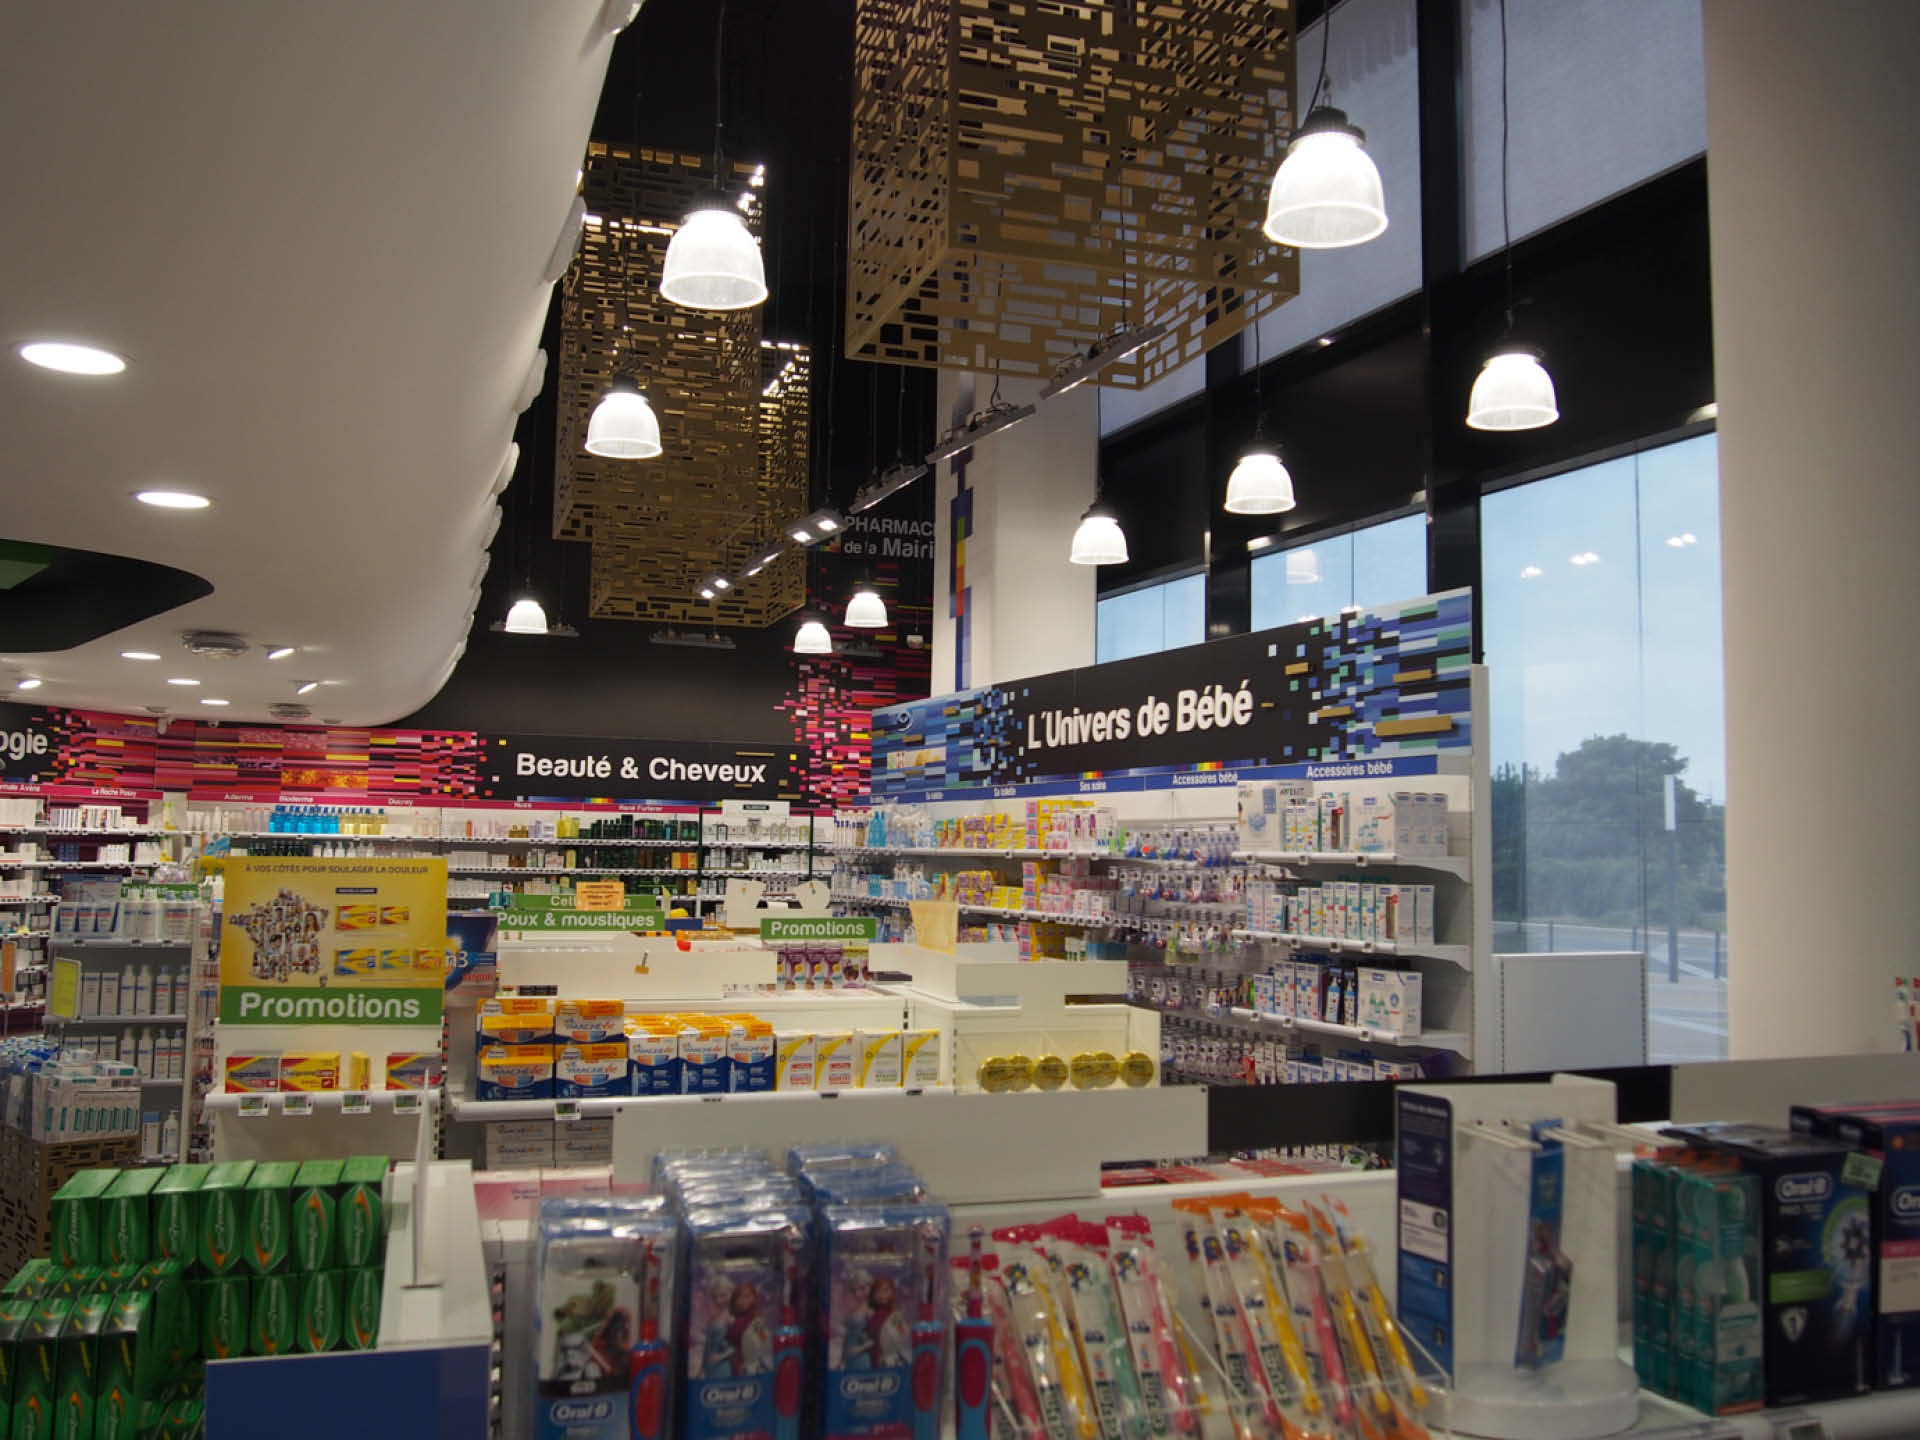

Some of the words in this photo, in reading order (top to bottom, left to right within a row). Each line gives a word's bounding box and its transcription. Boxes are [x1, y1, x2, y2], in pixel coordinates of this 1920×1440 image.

[844, 540, 862, 553] de
[865, 541, 877, 554] la
[1136, 695, 1171, 737] de
[1176, 679, 1254, 733] Bébé
[516, 753, 612, 778] Beauté
[620, 757, 640, 779] &
[649, 757, 766, 783] Cheveux
[1306, 763, 1365, 780] Accessoires
[1367, 760, 1393, 775] bébé
[1172, 773, 1217, 786] Accessoires
[254, 865, 271, 873] VOS
[302, 865, 326, 873] POUR
[328, 865, 373, 873] SOULAGER
[389, 866, 428, 874] DOULEUR
[497, 912, 538, 927] Poux
[544, 913, 557, 926] &
[561, 912, 655, 930] moustiques
[770, 919, 866, 937] Promotions
[239, 991, 421, 1019] Promotions
